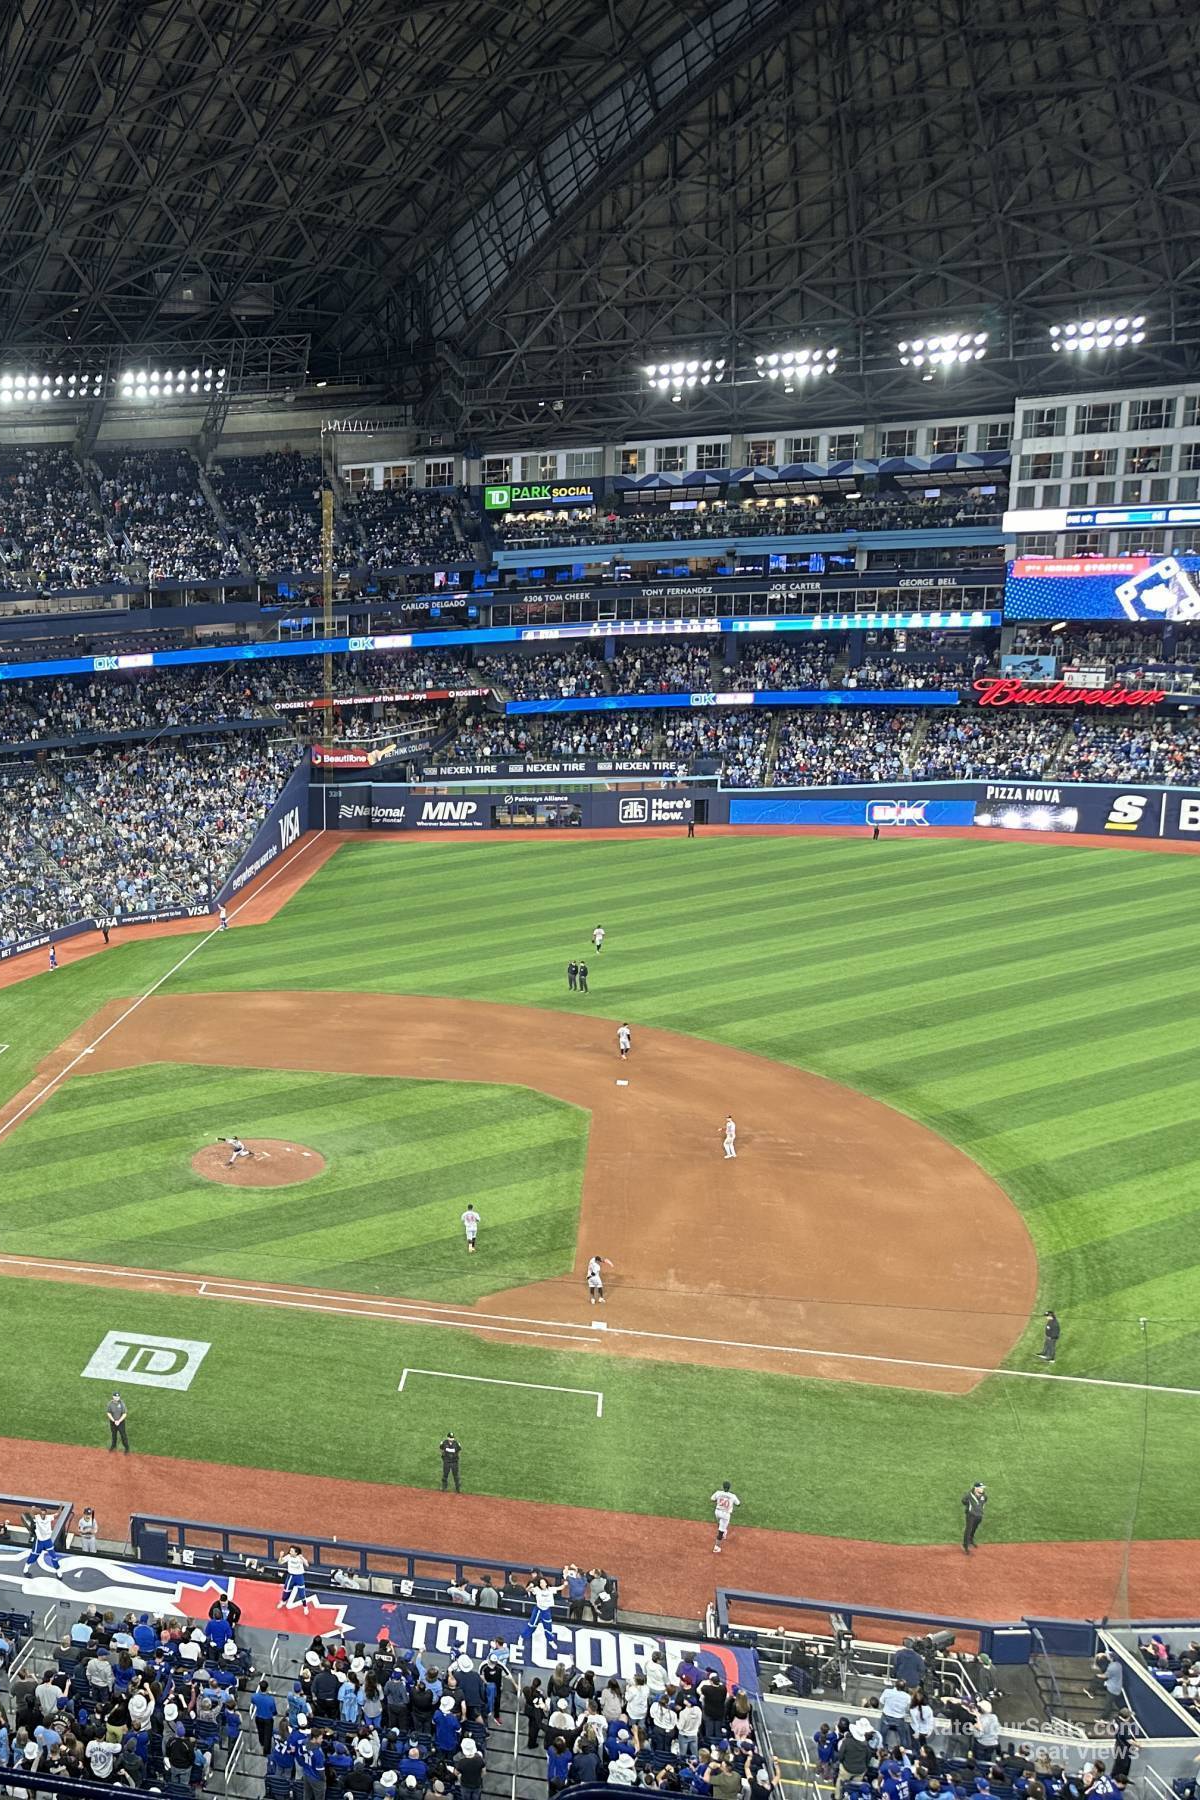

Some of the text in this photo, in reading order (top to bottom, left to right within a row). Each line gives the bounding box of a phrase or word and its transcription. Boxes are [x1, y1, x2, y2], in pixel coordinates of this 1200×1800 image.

[487, 485, 594, 505] TD PARK SOCIAL
[770, 582, 821, 591] JOE CARTER
[899, 577, 957, 587] GEORGE BELL
[642, 586, 713, 596] TONY FERNANDEZ
[523, 592, 591, 603] 4306 TOM CHEEK
[401, 599, 466, 611] CARLOS DELGADO
[348, 636, 375, 652] OK
[93, 655, 119, 671] OK
[455, 689, 479, 697] ROGERS
[974, 678, 1167, 706] Budweiser
[281, 701, 305, 709] ROGERS
[333, 692, 427, 706] Proud owner of the Blue Jays
[690, 692, 717, 706] OK
[440, 766, 473, 775] NEXEN
[474, 765, 497, 774] TIRE
[526, 764, 560, 773] NEXEN
[562, 762, 585, 771] TIRE
[615, 761, 650, 770] NEXEN
[652, 761, 676, 770] TIRE
[986, 785, 1060, 803] PIZZA NOVA
[421, 801, 477, 819] MNP
[651, 798, 692, 810] Here's
[651, 809, 684, 821] How.
[278, 806, 300, 850] VISA
[186, 904, 210, 917] VISA
[94, 917, 118, 929] VISA
[1, 948, 12, 958] BET
[114, 1340, 190, 1376] TD
[406, 1613, 470, 1654] TO
[471, 1637, 525, 1665] TE
